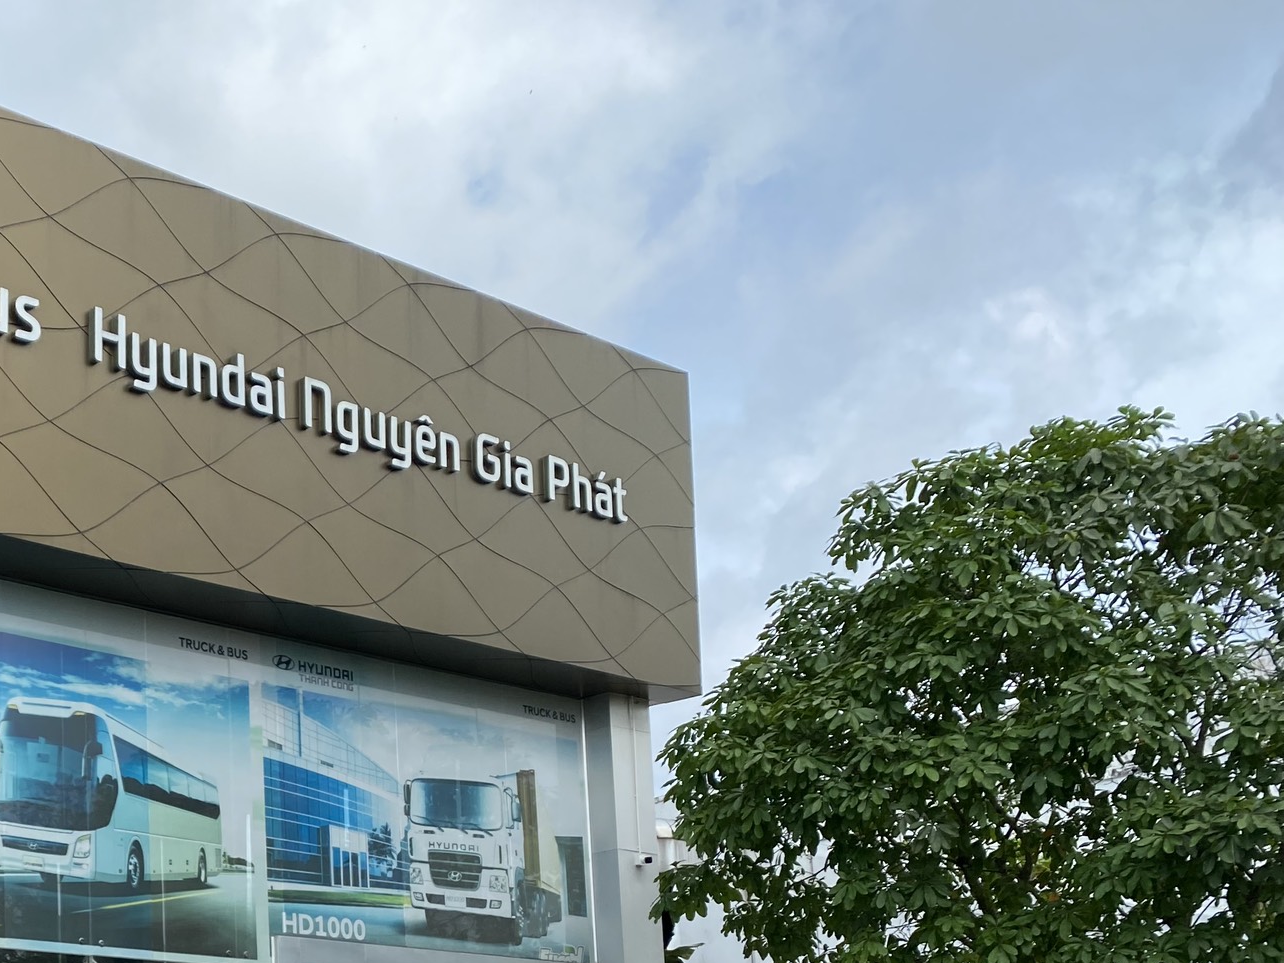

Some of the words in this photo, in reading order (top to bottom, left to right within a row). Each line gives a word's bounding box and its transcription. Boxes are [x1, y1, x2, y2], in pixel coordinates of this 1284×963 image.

[89, 305, 286, 420] Hyundai
[299, 376, 460, 472] Nguyên
[473, 432, 534, 495] Gia
[543, 454, 628, 523] Phát
[178, 636, 216, 654] TRUCK
[217, 645, 225, 656] &
[227, 646, 248, 660] BUS
[298, 660, 354, 682] HYUNDAI
[299, 673, 330, 687] THANH
[522, 704, 551, 718] TRUCK
[552, 710, 559, 719] &
[560, 711, 576, 723] BUS
[428, 841, 480, 852] HYUNDAI
[282, 911, 366, 940] HD1000
